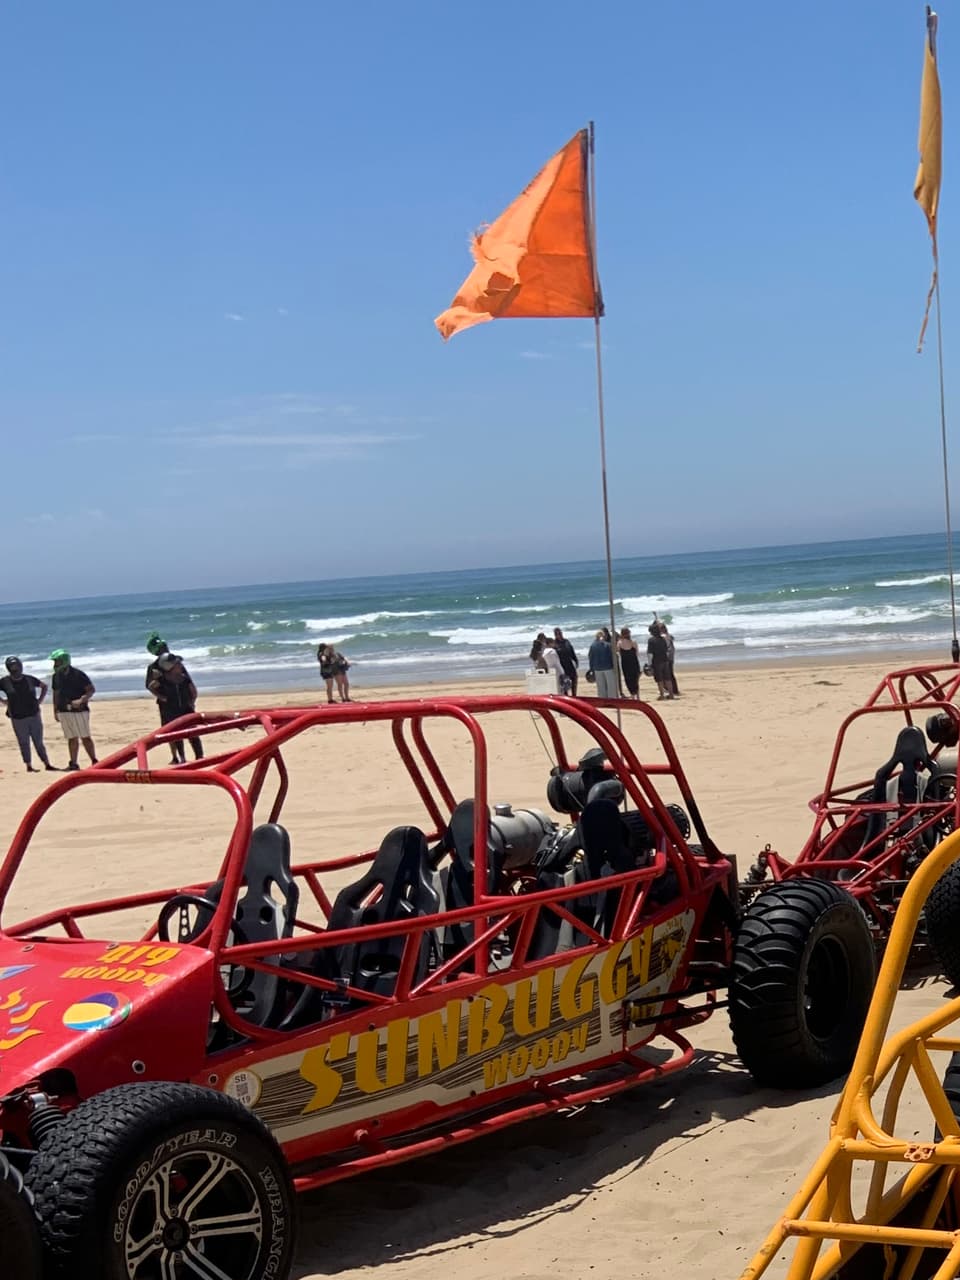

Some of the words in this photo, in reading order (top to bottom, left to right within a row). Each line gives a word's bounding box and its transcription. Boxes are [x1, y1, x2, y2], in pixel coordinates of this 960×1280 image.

[59, 966, 171, 987] WOODY
[96, 945, 182, 968] 419
[300, 924, 654, 1114] SUNBUGGY
[482, 1021, 590, 1090] WOODY
